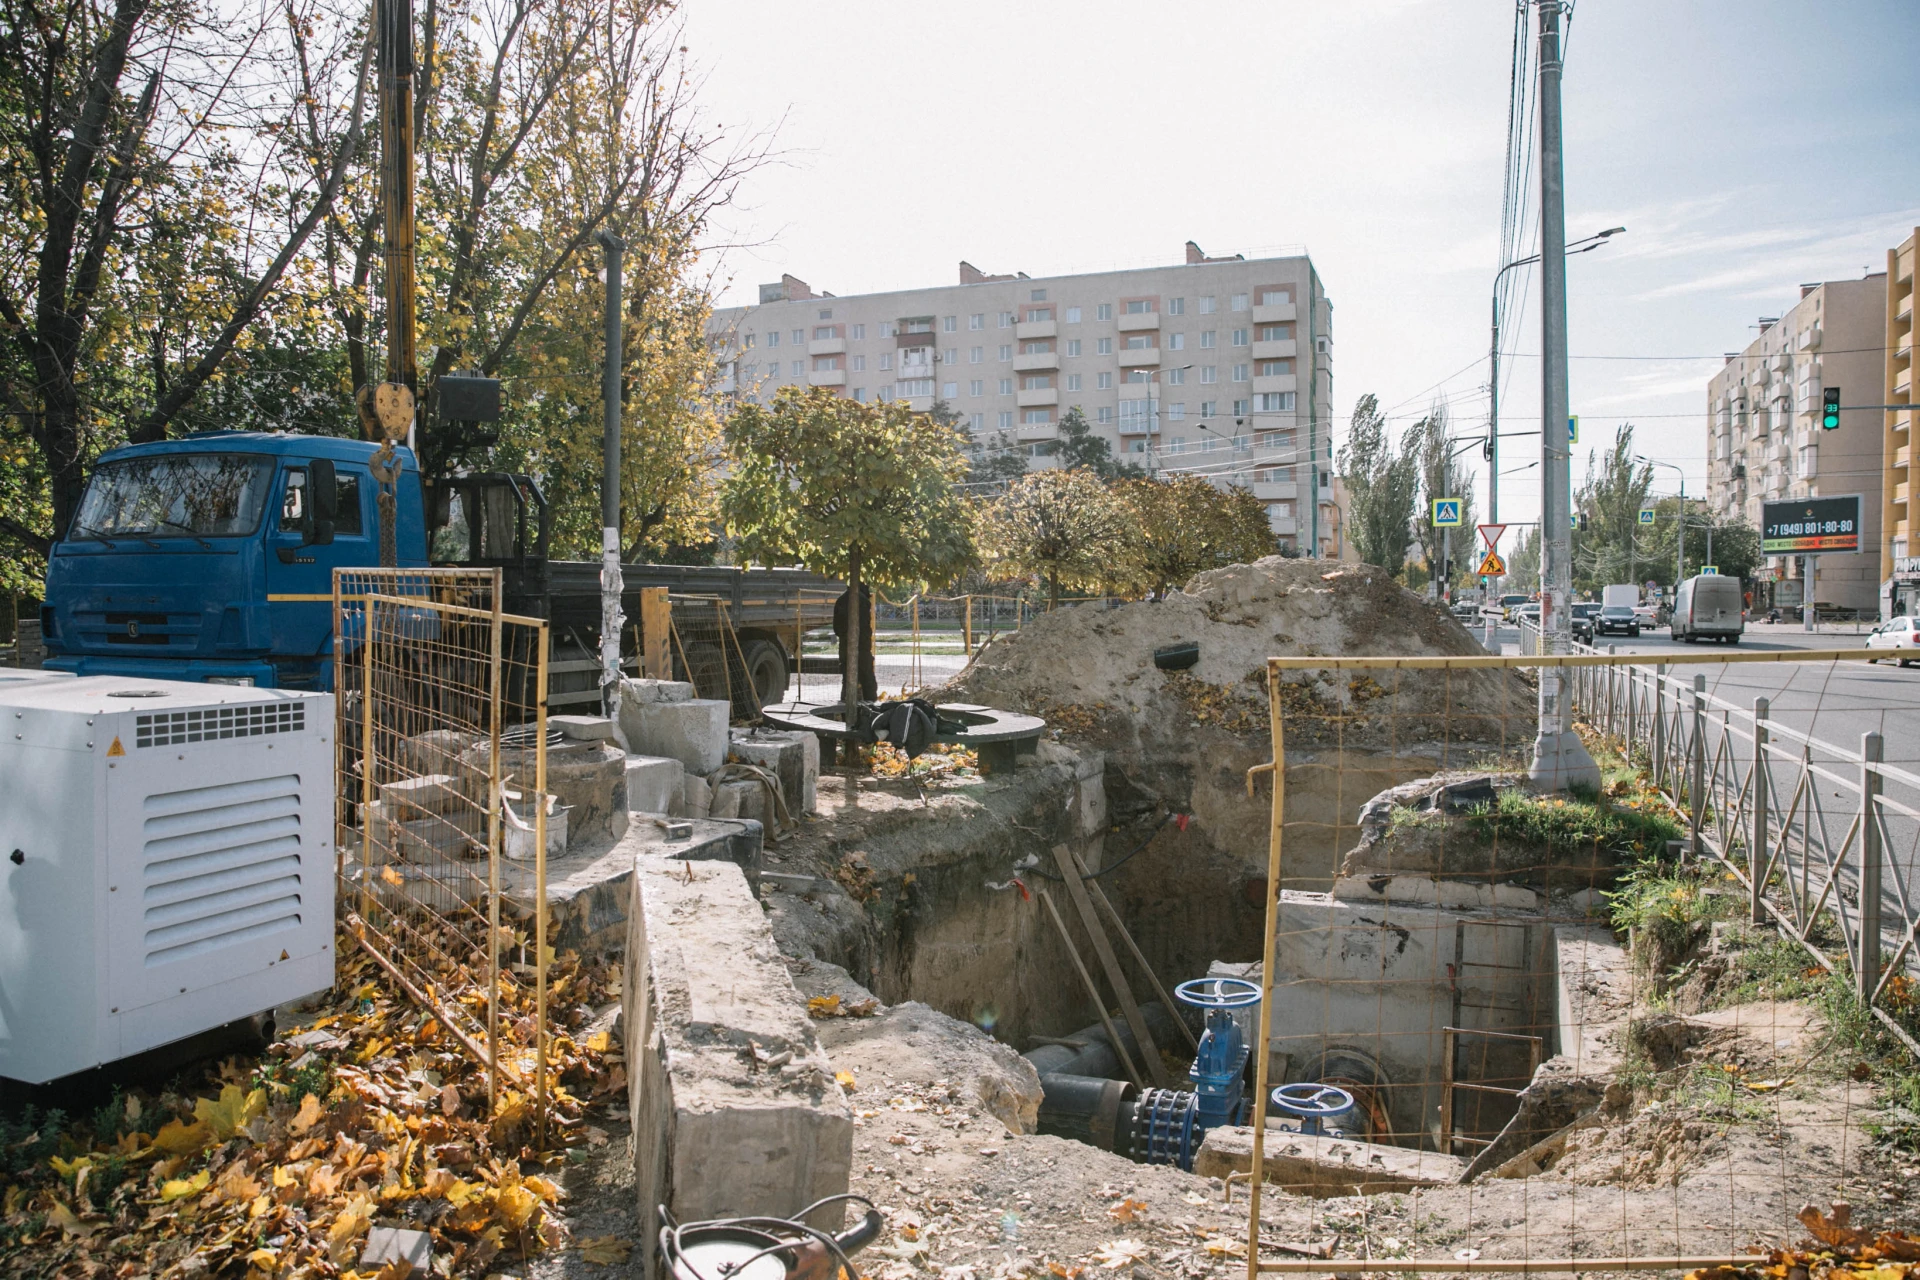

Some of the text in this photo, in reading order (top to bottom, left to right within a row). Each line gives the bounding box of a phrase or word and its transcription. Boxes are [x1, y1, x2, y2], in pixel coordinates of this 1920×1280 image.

[1827, 403, 1838, 412] 33
[1767, 520, 1853, 536] +7 (949) 801-80-80
